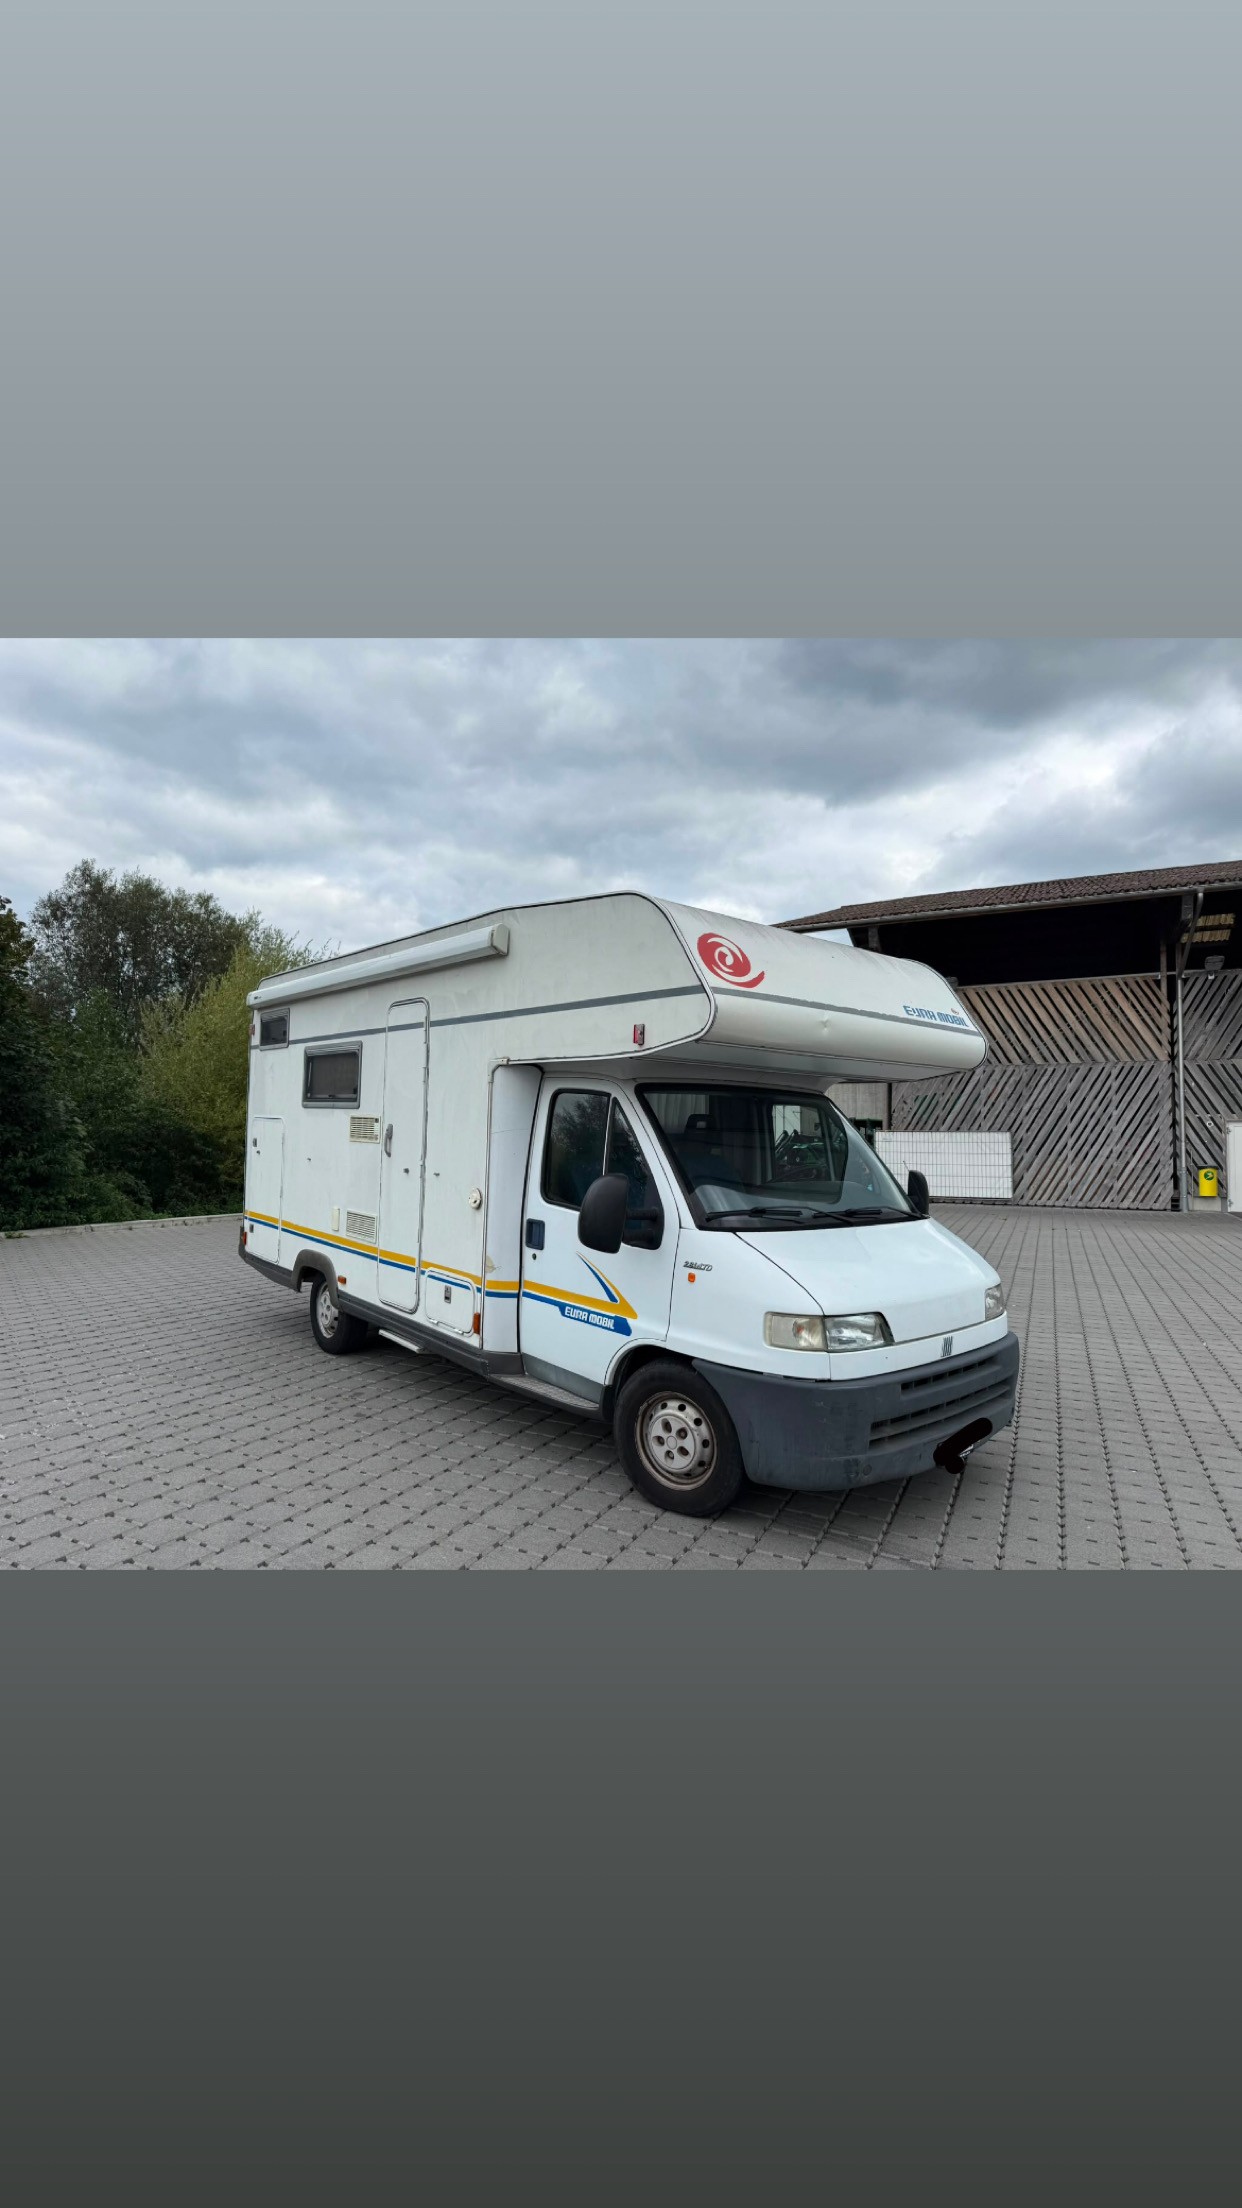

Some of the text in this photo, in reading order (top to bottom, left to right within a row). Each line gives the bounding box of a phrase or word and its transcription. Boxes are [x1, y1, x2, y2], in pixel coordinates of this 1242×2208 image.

[903, 1005, 969, 1027] EURA MOBIL
[564, 1306, 615, 1330] EURA MOBIL
